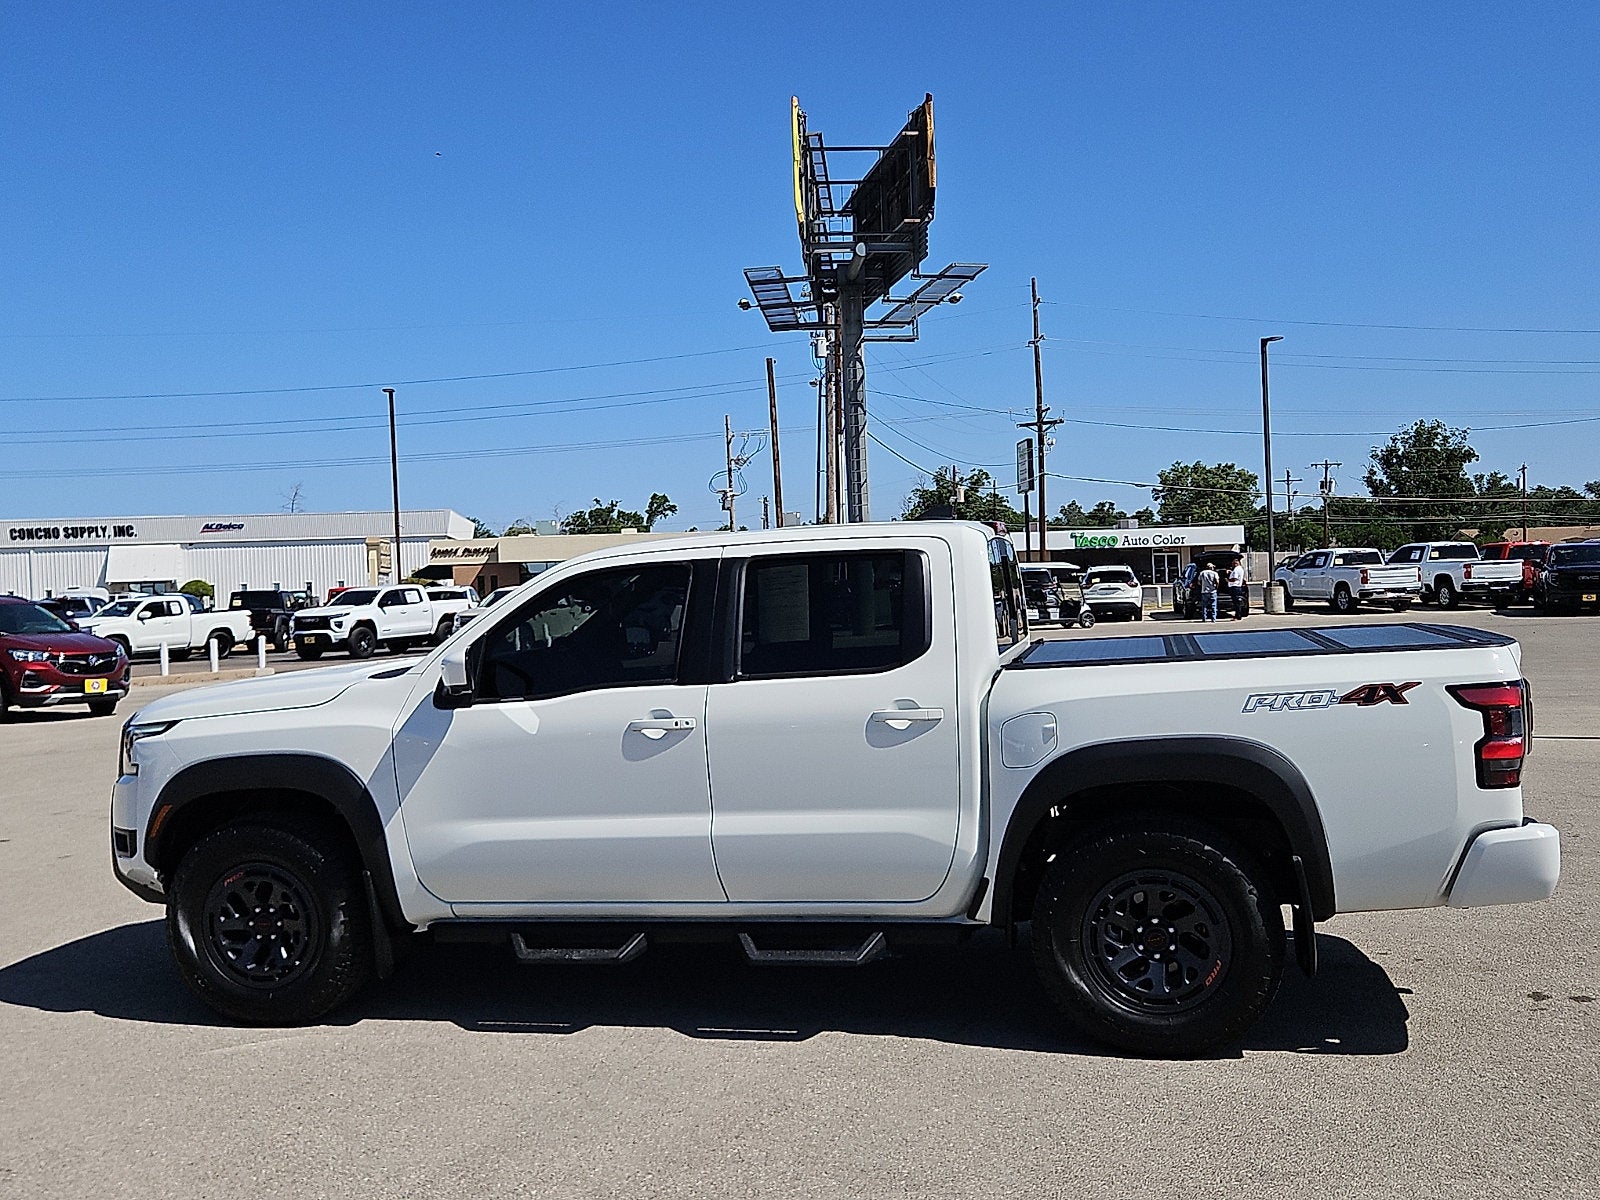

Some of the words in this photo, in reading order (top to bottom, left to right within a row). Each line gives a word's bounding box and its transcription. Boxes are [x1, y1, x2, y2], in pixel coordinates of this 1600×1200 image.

[9, 527, 60, 541] CONCHO
[62, 525, 111, 539] SUPPLY,
[113, 525, 138, 538] INC.
[1072, 533, 1118, 548] TASCO
[1122, 536, 1149, 546] Auto
[1152, 534, 1187, 545] Color
